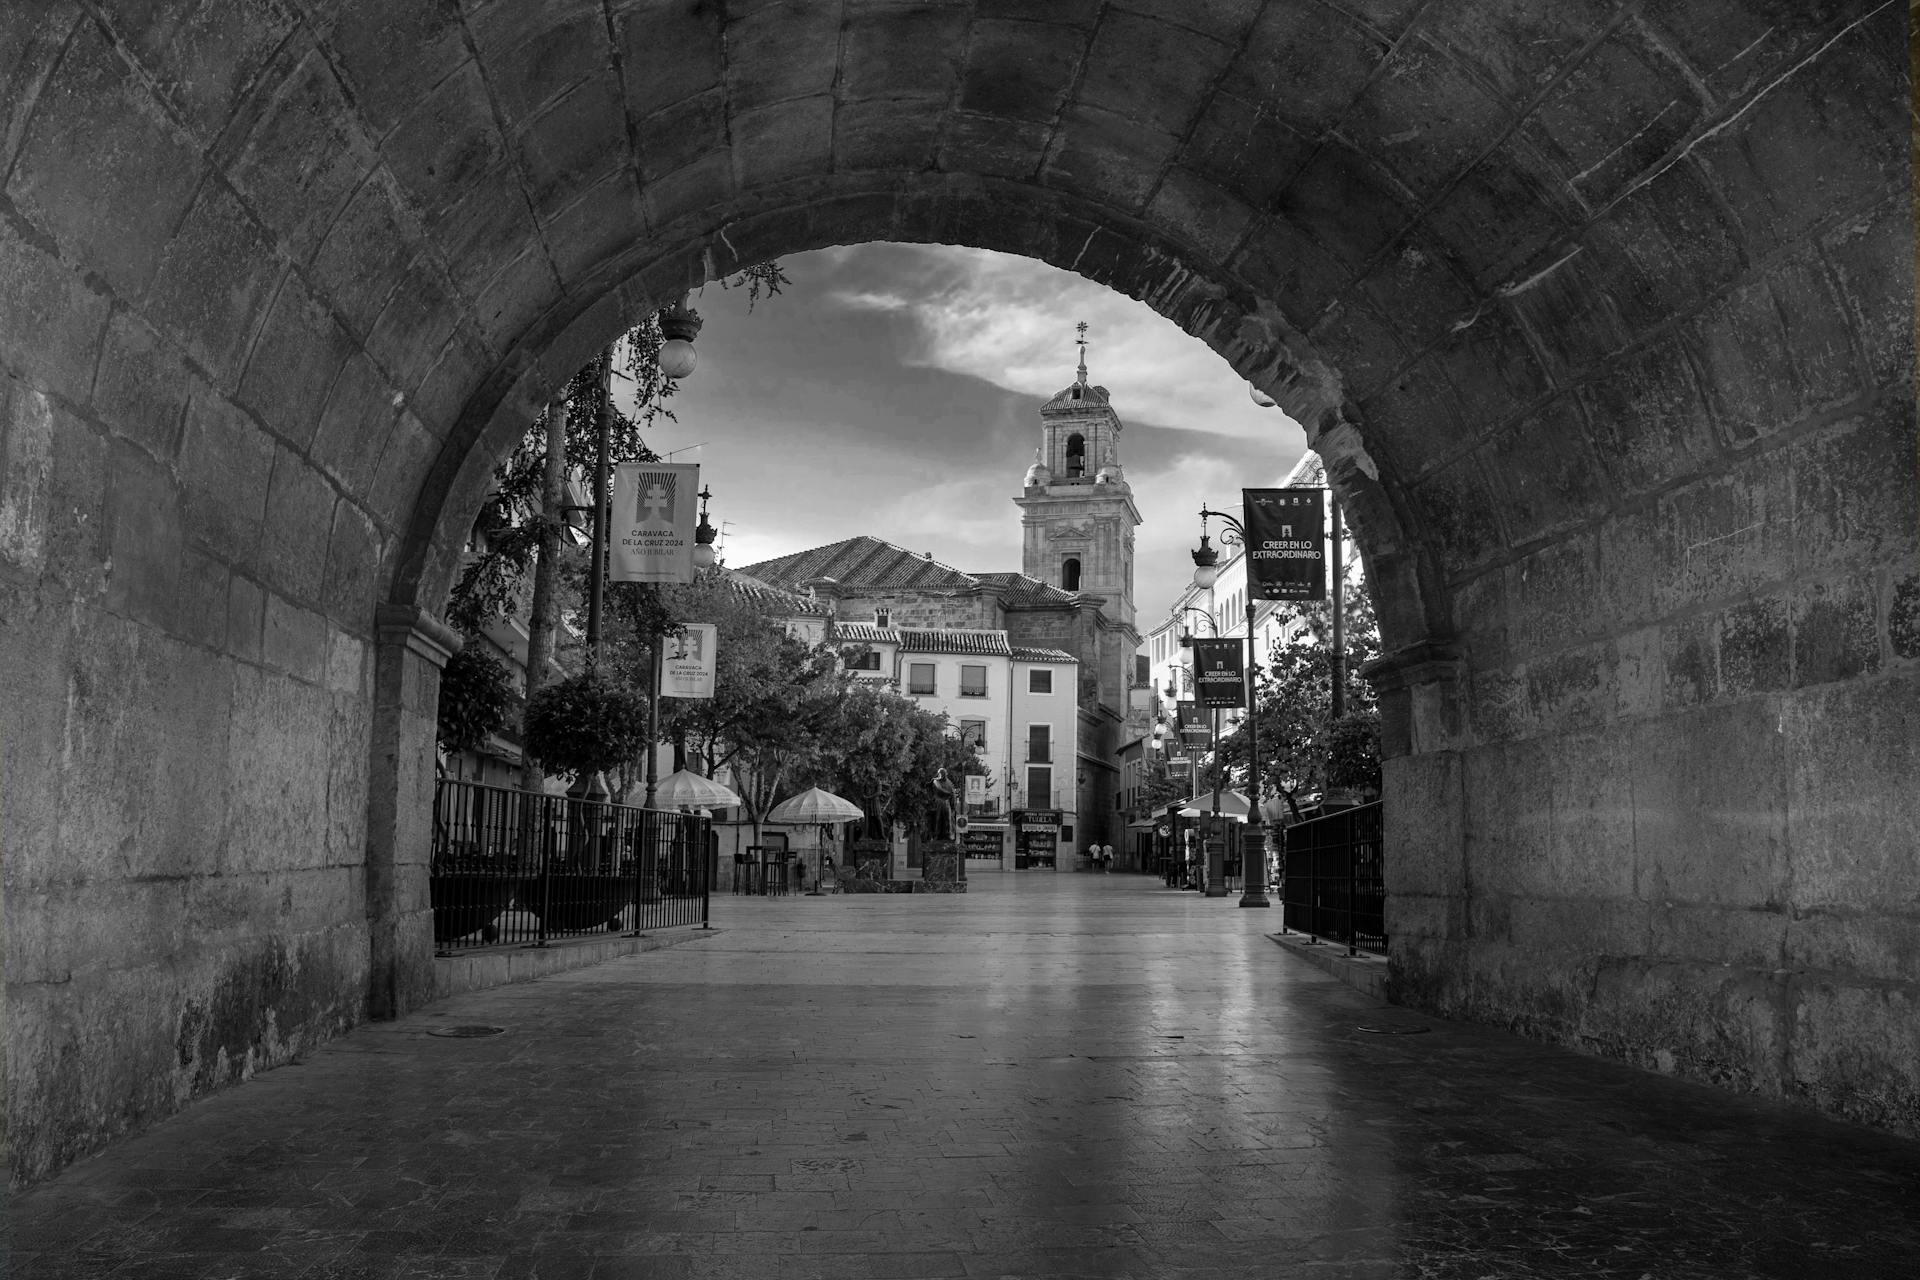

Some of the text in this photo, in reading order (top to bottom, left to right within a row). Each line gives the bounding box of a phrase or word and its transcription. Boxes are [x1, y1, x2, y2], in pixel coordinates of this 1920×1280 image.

[644, 539, 664, 547] CRUZ
[665, 539, 684, 547] 2024
[1262, 540, 1312, 549] CREER EN LO
[1252, 550, 1322, 560] EXTRAORDINARIO
